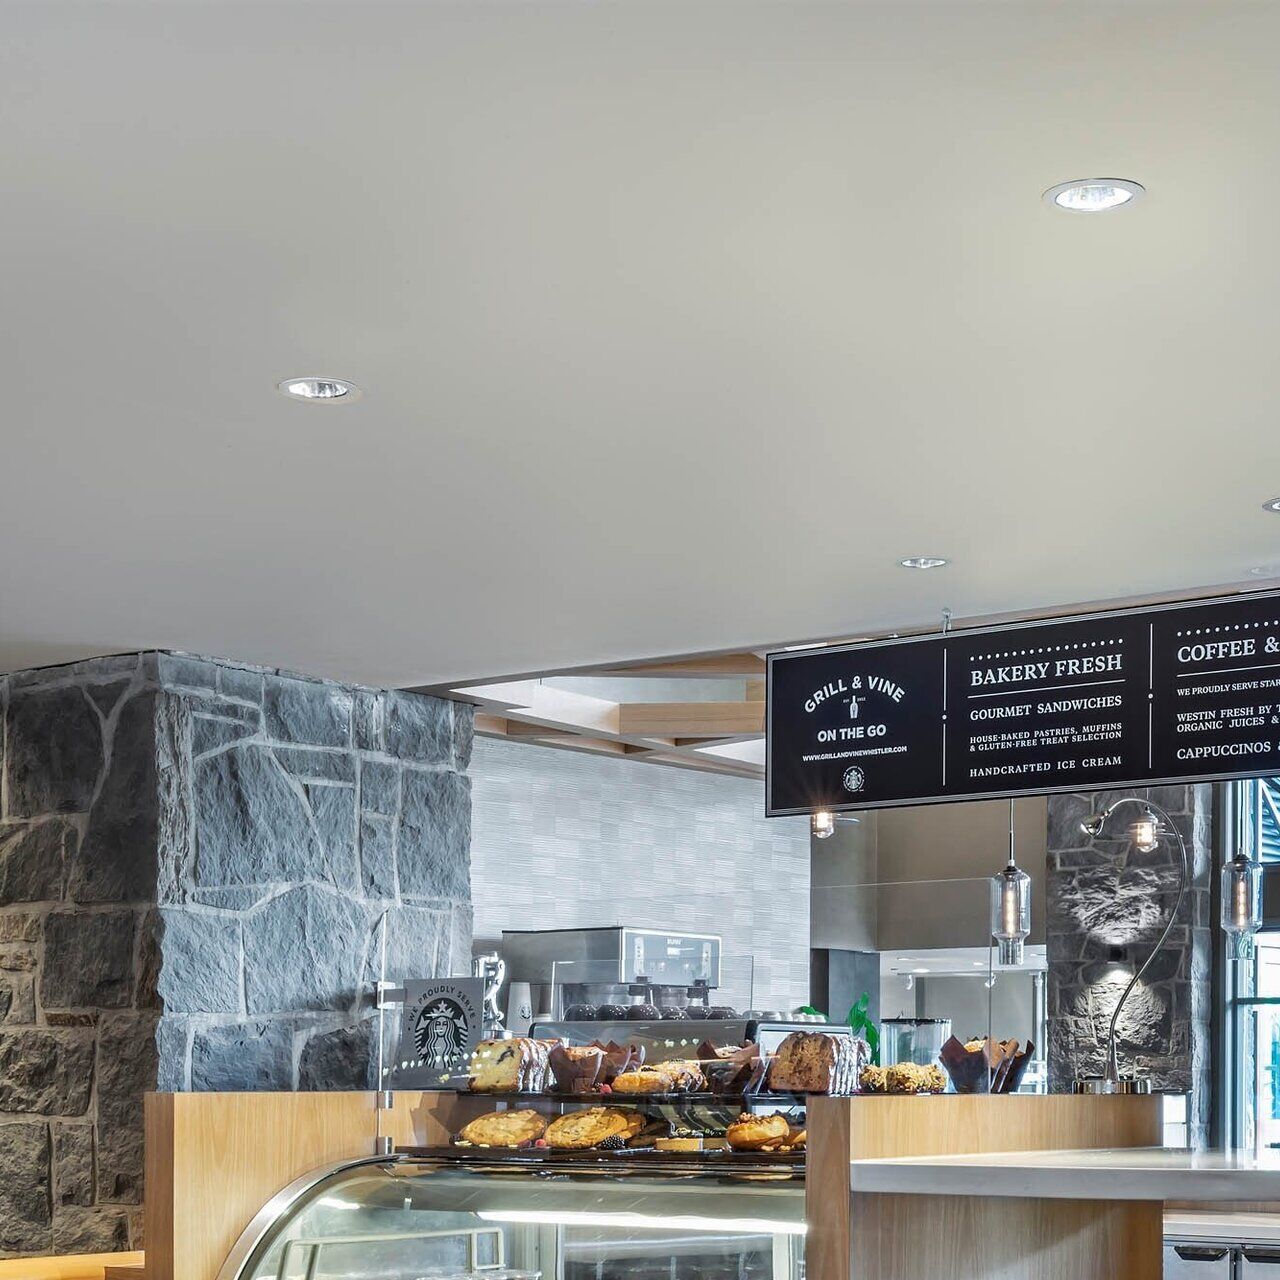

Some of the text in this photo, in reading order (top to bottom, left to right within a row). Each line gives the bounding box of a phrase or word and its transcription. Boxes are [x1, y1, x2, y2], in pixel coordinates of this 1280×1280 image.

[1177, 639, 1256, 663] COFFEE
[1264, 636, 1280, 653] &
[970, 654, 1123, 686] BAKERY FRESH
[804, 675, 906, 713] GRILL & VINE
[1176, 688, 1191, 696] WE
[1192, 683, 1232, 695] PROUDLY
[1231, 681, 1259, 691] SERVE
[970, 695, 1122, 721] GOURMET SANDWICHES
[1176, 710, 1216, 722] WESTIN
[1220, 708, 1254, 719] FRESH
[1258, 705, 1272, 715] BY
[817, 724, 887, 742] ON THE GO
[970, 731, 1030, 744] HOUSE-BAKED
[1082, 723, 1122, 733] MUFFINS
[1176, 720, 1223, 733] ORGANIC
[1228, 716, 1265, 728] JUICES
[1271, 715, 1280, 724] &
[978, 739, 1038, 751] GLUTEN-FREE
[1040, 735, 1070, 745] TREAT
[1072, 731, 1122, 743] SELECTION
[1176, 741, 1271, 760] CAPPUCCINOS
[802, 745, 908, 762] WWW.GRILLANDVINEWHISTLER.COM
[970, 756, 1122, 777] HANDCRAFTED ICE CREAM
[408, 985, 477, 1021] WE PROUDLY SERVE
